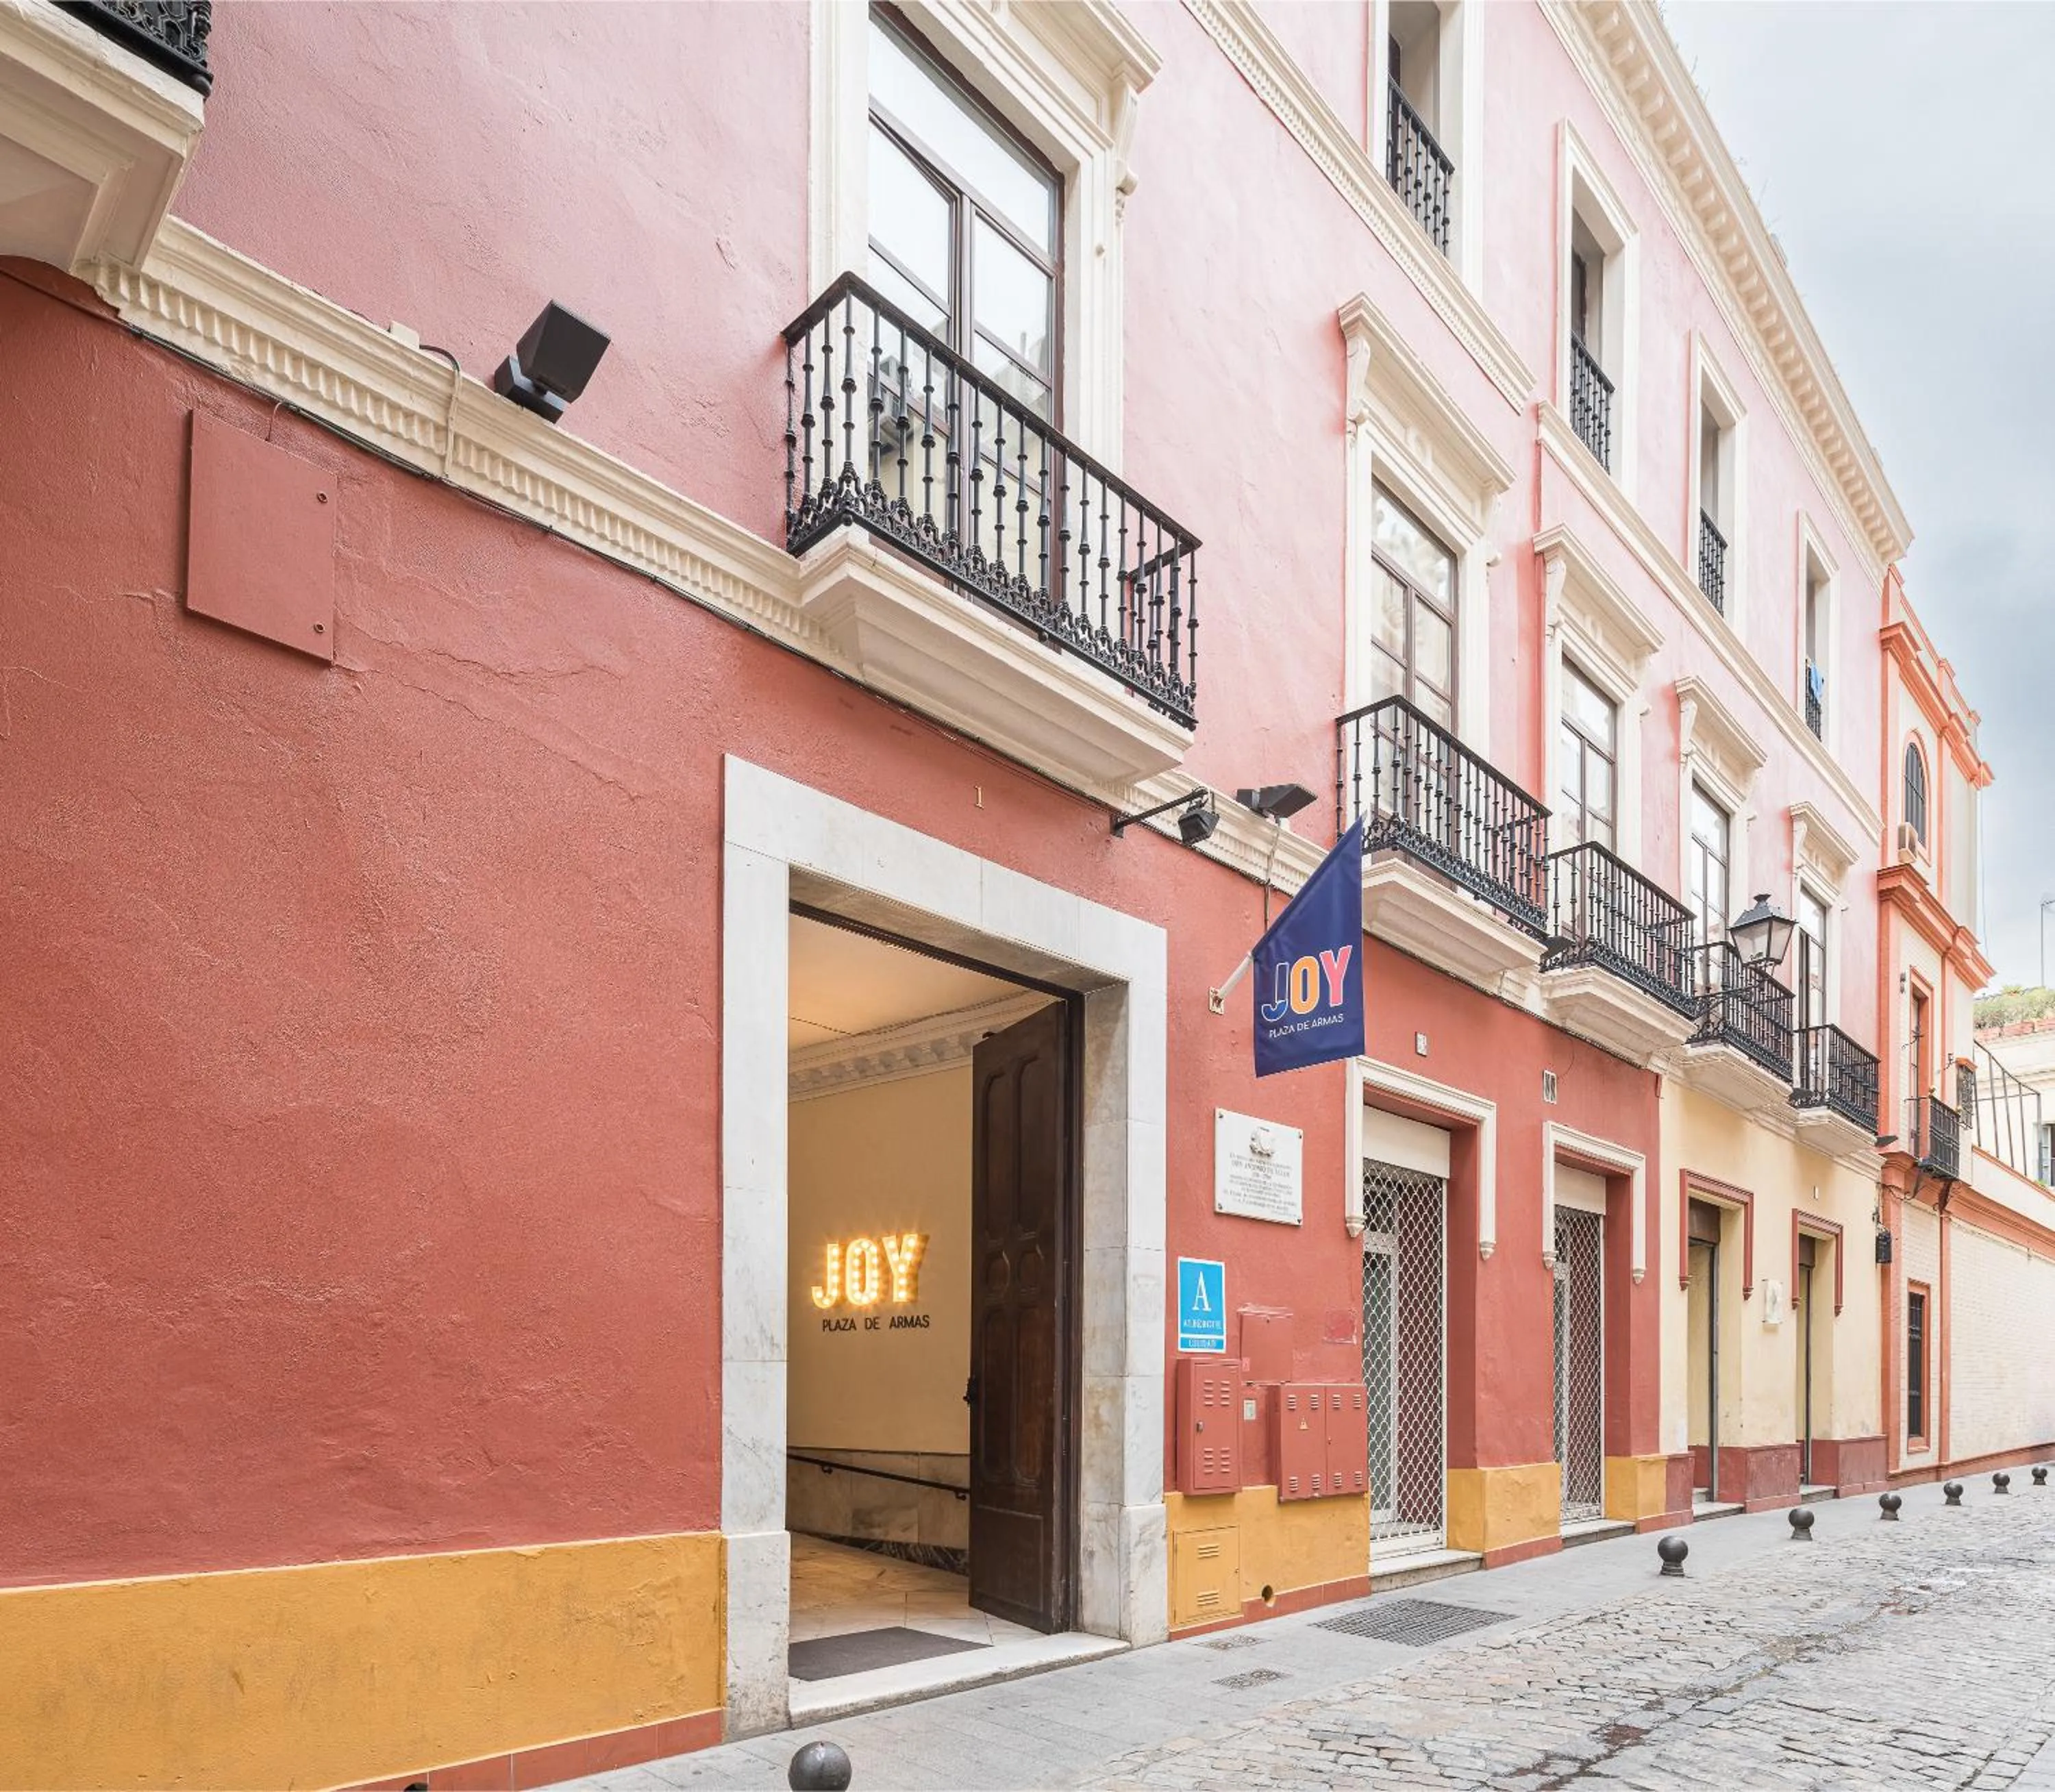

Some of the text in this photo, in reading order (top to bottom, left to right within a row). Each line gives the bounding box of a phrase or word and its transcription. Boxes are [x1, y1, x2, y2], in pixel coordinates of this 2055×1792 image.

[1261, 945, 1353, 1022] JOY
[1269, 1013, 1344, 1038] PLAZA DE ARMAS
[811, 1234, 927, 1309] JOY
[1192, 1271, 1212, 1312] A
[823, 1315, 930, 1332] PLAZA DE ARMAS
